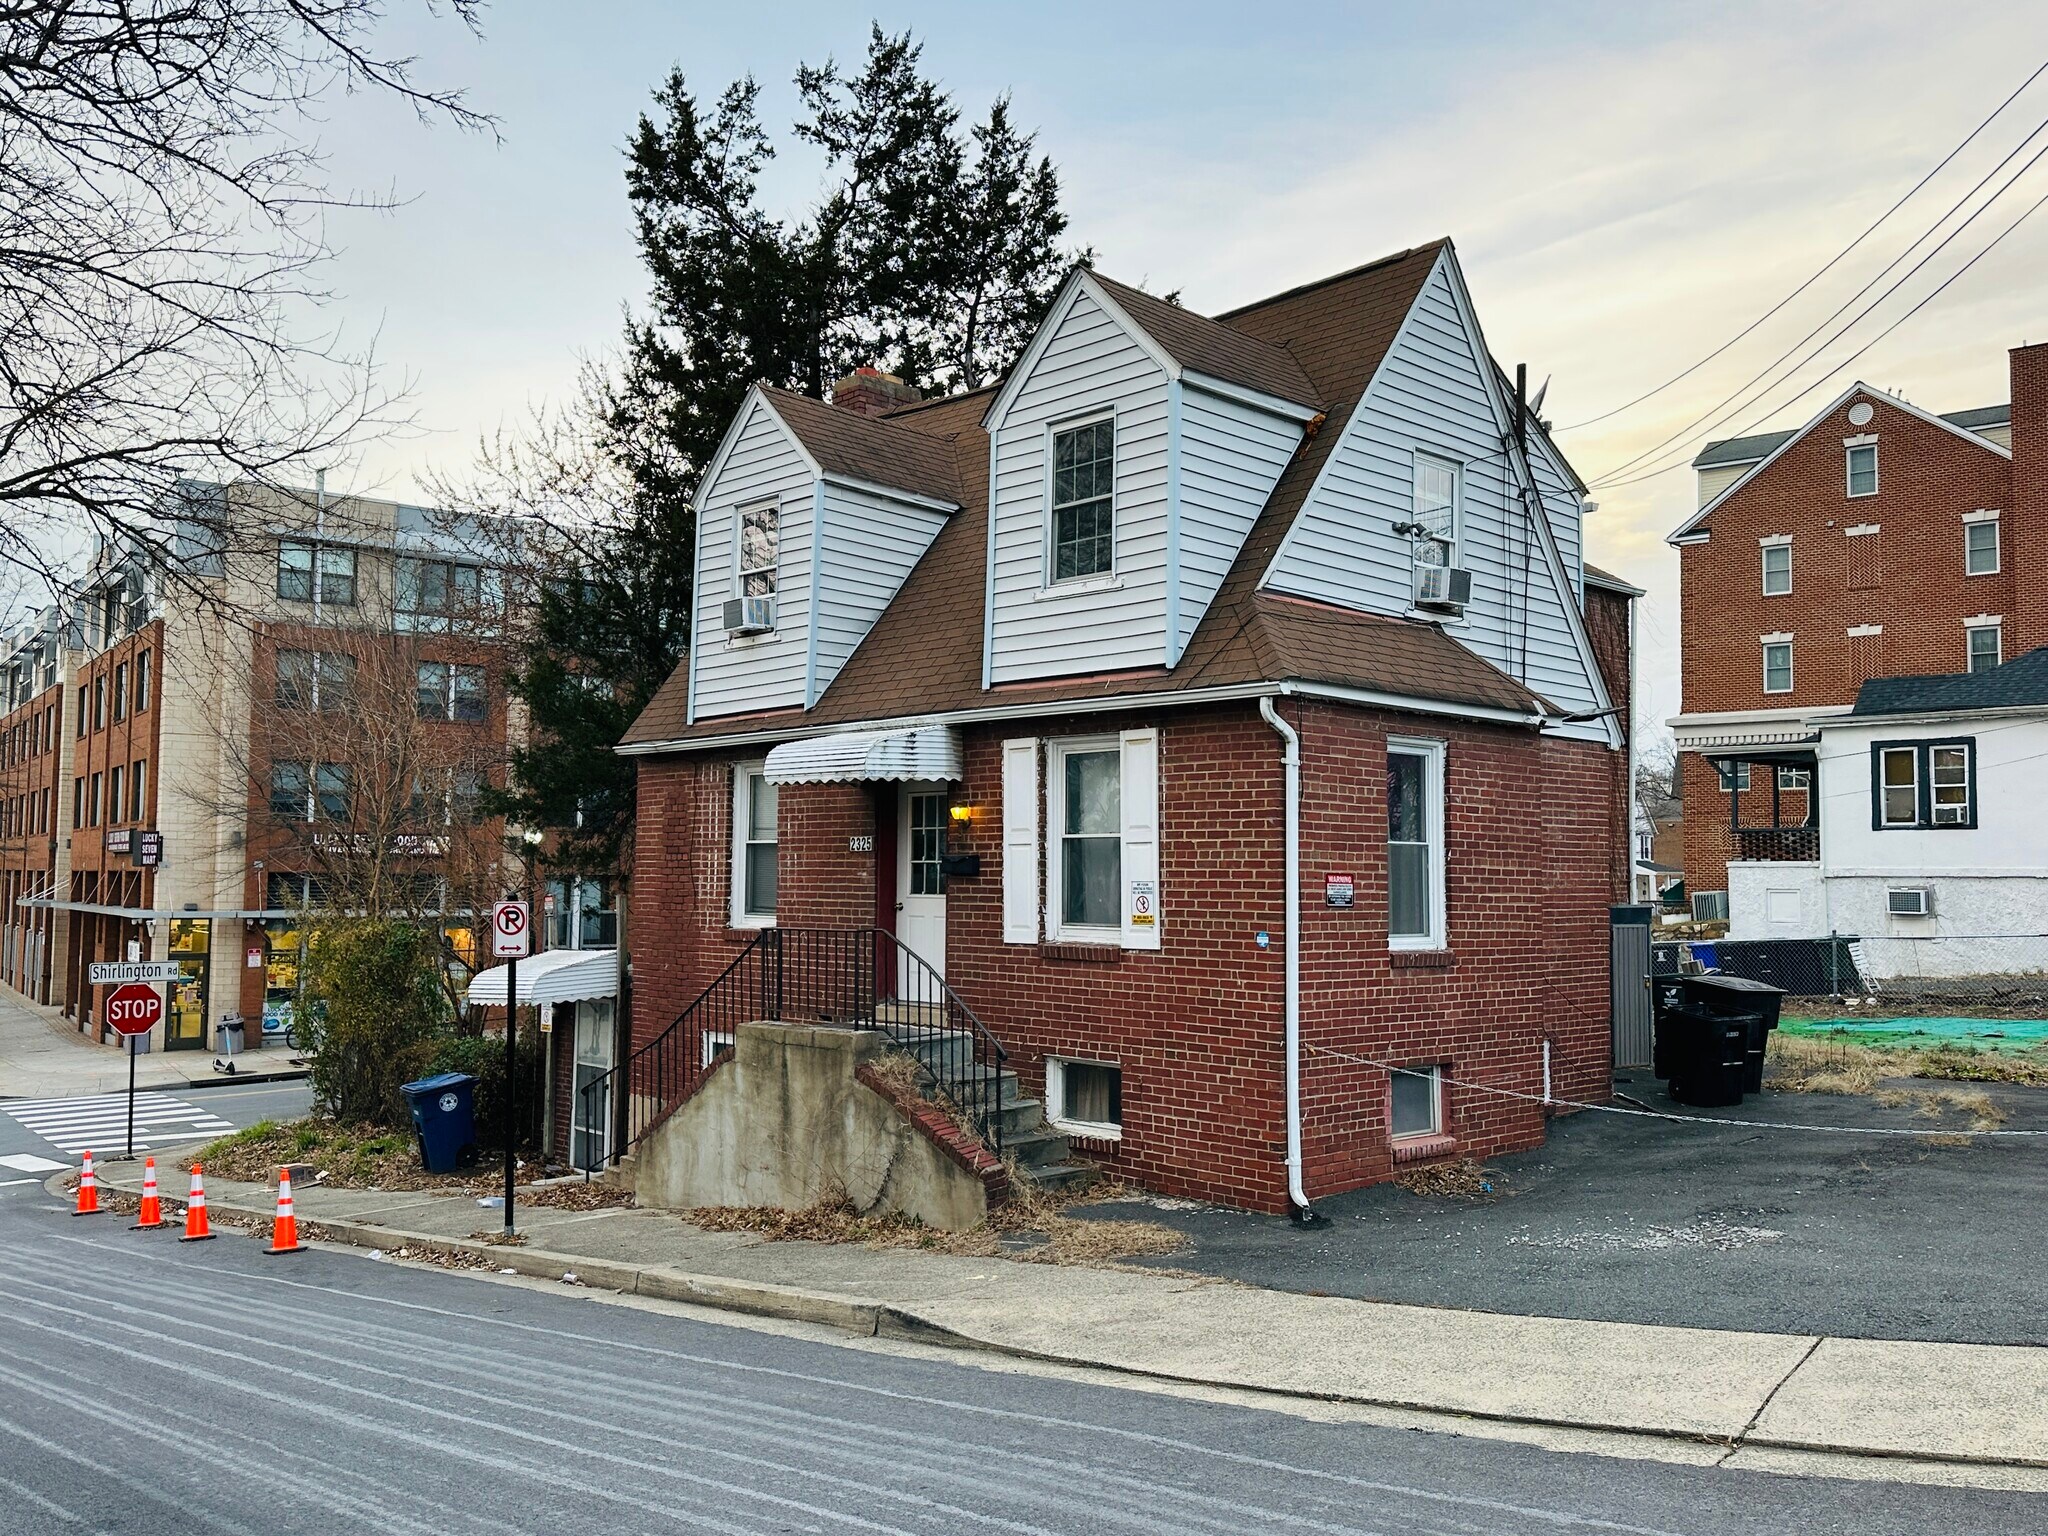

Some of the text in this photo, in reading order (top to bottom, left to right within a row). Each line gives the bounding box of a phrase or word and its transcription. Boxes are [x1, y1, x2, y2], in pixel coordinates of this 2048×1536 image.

[142, 833, 158, 843] LUCKY
[851, 837, 871, 850] 2325
[141, 844, 158, 854] SEVEN
[142, 855, 156, 865] MART
[1328, 875, 1352, 883] WARNING
[92, 964, 178, 981] Shirlington Rd
[111, 999, 159, 1020] STOP
